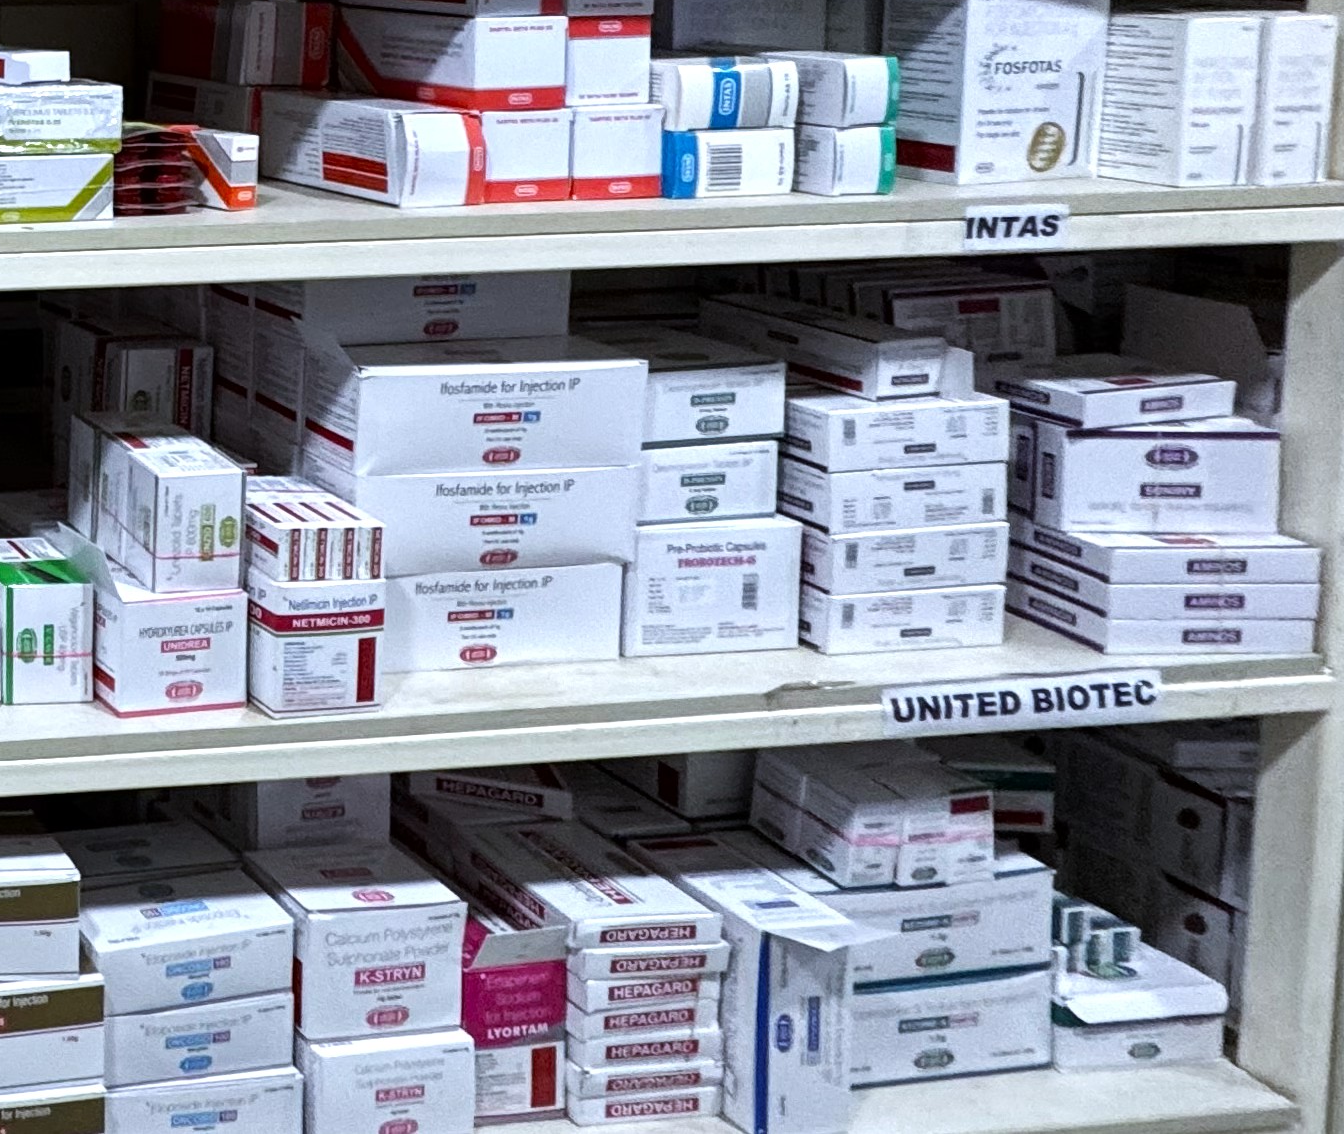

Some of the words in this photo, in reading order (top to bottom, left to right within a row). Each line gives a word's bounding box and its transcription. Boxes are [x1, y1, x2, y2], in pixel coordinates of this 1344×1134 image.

[994, 60, 1063, 75] FOSFOTAS
[965, 214, 1061, 241] INTAS
[441, 380, 496, 395] Ifosfamide
[499, 381, 516, 392] for
[519, 378, 566, 393] Injection
[569, 378, 580, 390] IP
[292, 615, 371, 628] NETMICIN-300
[164, 640, 208, 650] UNIDREA
[891, 689, 1021, 722] UNITED
[1033, 681, 1157, 713] BIOTEC
[606, 927, 690, 941] HEPAGARD
[617, 957, 700, 972] HEPAGARD
[359, 966, 422, 983] K-STRYN
[614, 981, 692, 998] HEPAGARD
[609, 1010, 689, 1026] HEPAGARD
[487, 1023, 548, 1039] LYORTAM
[613, 1042, 693, 1058] HEPAGARD
[378, 1086, 422, 1100] K-STRYN
[611, 1100, 693, 1116] HEPAGARD
